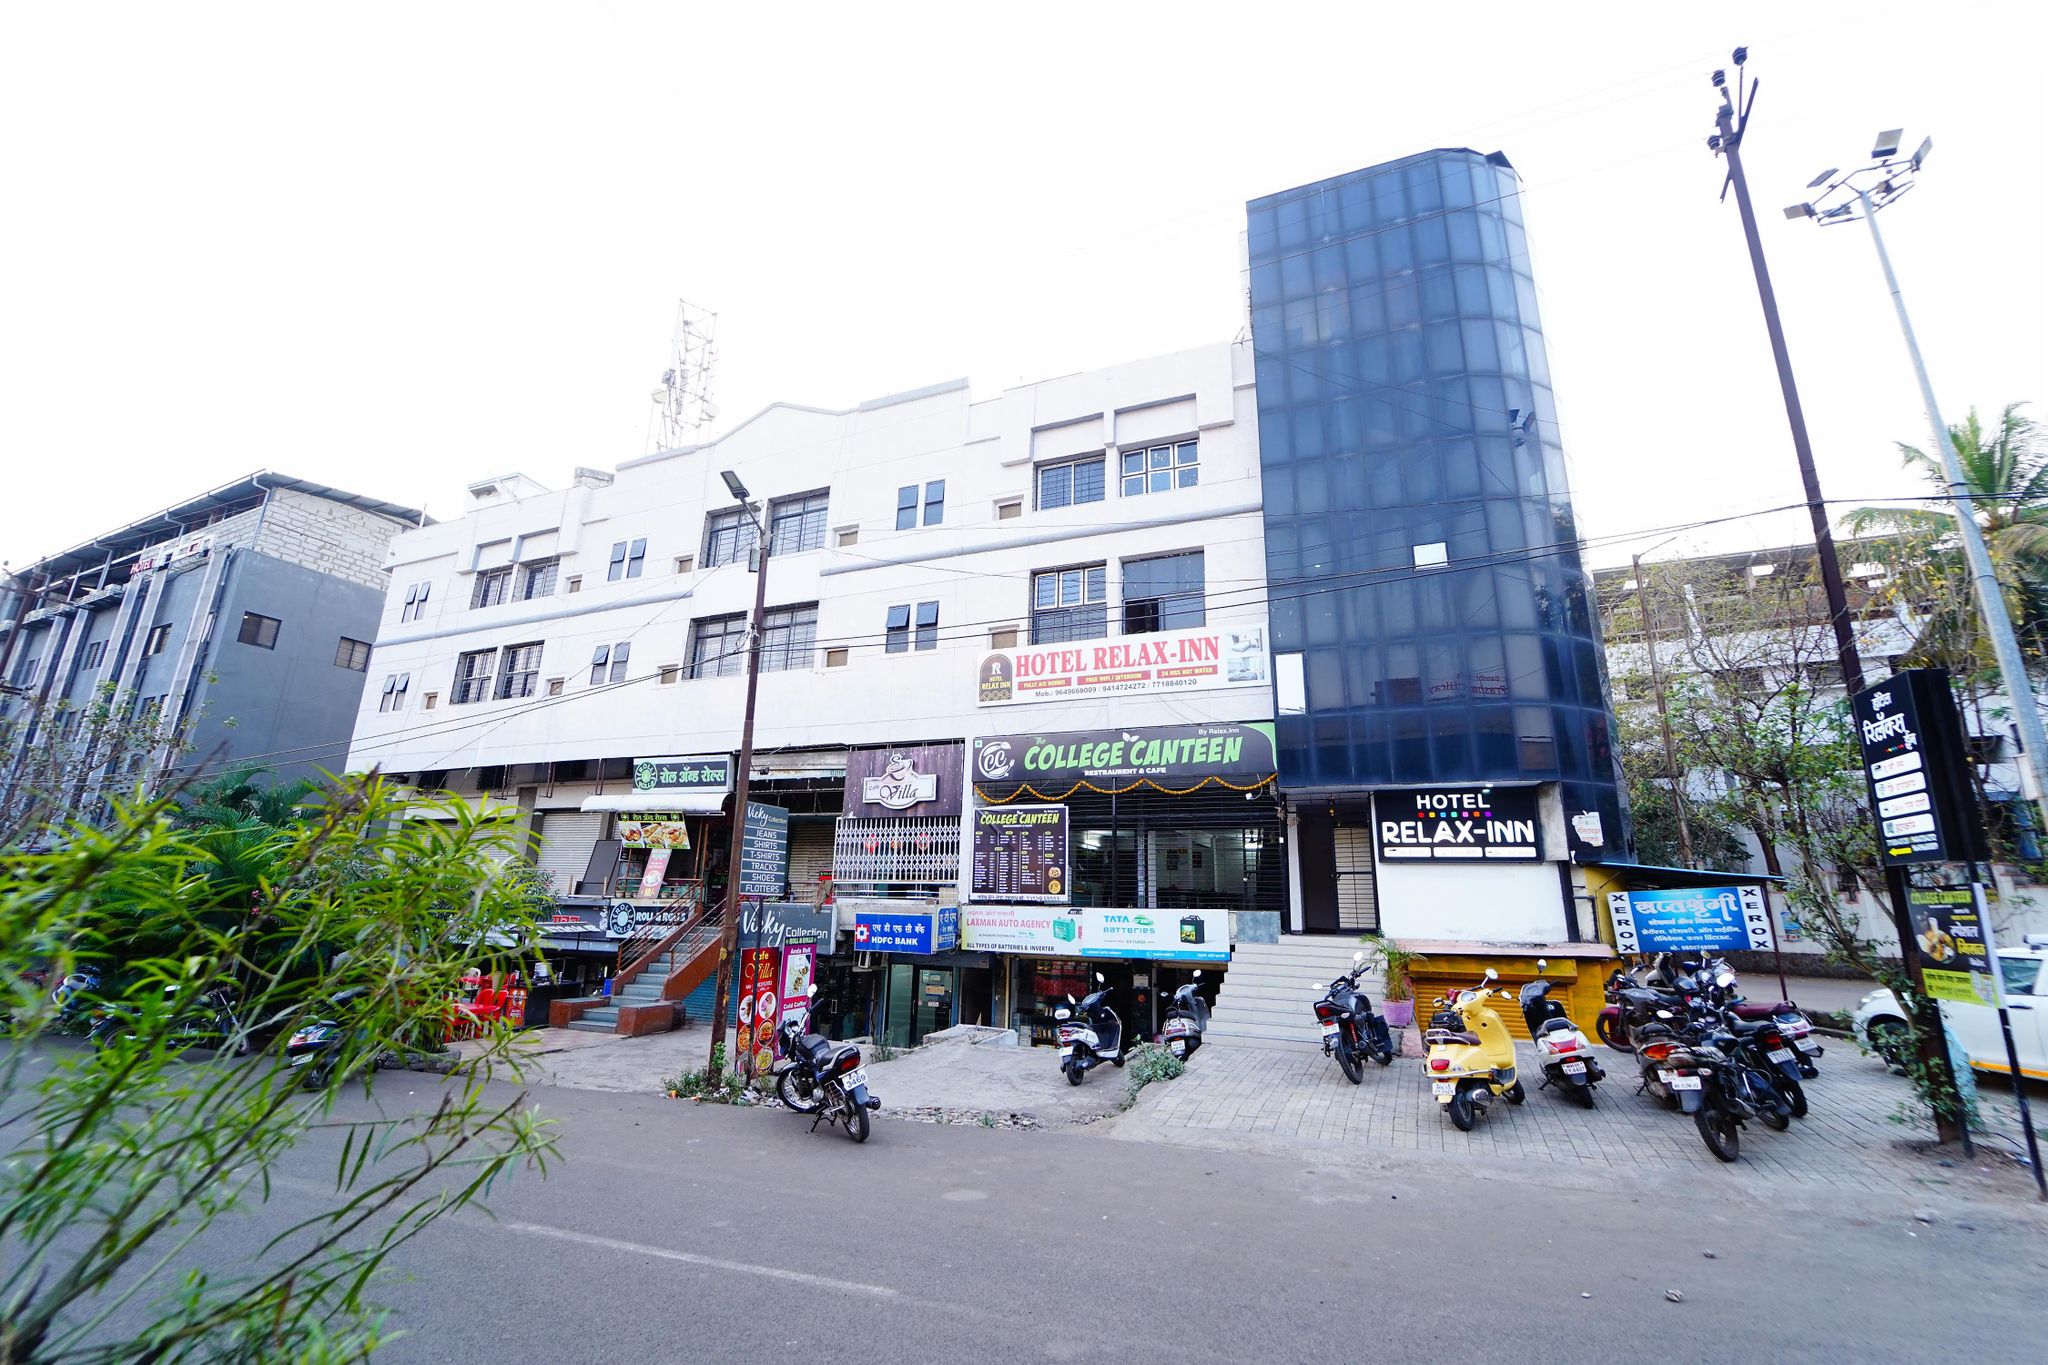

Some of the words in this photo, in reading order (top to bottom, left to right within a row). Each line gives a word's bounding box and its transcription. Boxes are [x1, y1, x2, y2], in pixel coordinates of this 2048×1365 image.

[1015, 649, 1088, 677] HOTEL
[1092, 636, 1219, 671] RELAX-INN
[1024, 741, 1125, 771] COLLEGE
[1129, 736, 1244, 766] CANTEEN
[880, 784, 918, 800] Villa
[1416, 794, 1490, 809] HOTEL
[980, 813, 1018, 825] COLLEGE
[1019, 813, 1059, 825] CANTEEN
[756, 829, 777, 839] JEANS
[1381, 820, 1535, 844] RELAX-INN
[754, 840, 778, 850] SHIRTS
[750, 851, 780, 861] T-SHIRTS
[751, 862, 778, 872] TRACKS
[752, 873, 775, 882] SHOES
[745, 884, 780, 893] FLOTTERS
[966, 918, 997, 927] LAXMAN
[999, 919, 1018, 928] AUTO
[1020, 920, 1051, 929] AGENCY
[1104, 915, 1129, 923] TATA
[1612, 894, 1636, 951] XEROX
[1742, 889, 1769, 948] XEROX
[743, 906, 786, 948] Viky
[785, 926, 829, 940] Collection
[871, 936, 893, 945] HDFC
[894, 937, 918, 946] BANK
[998, 943, 1024, 951] BATTERIES
